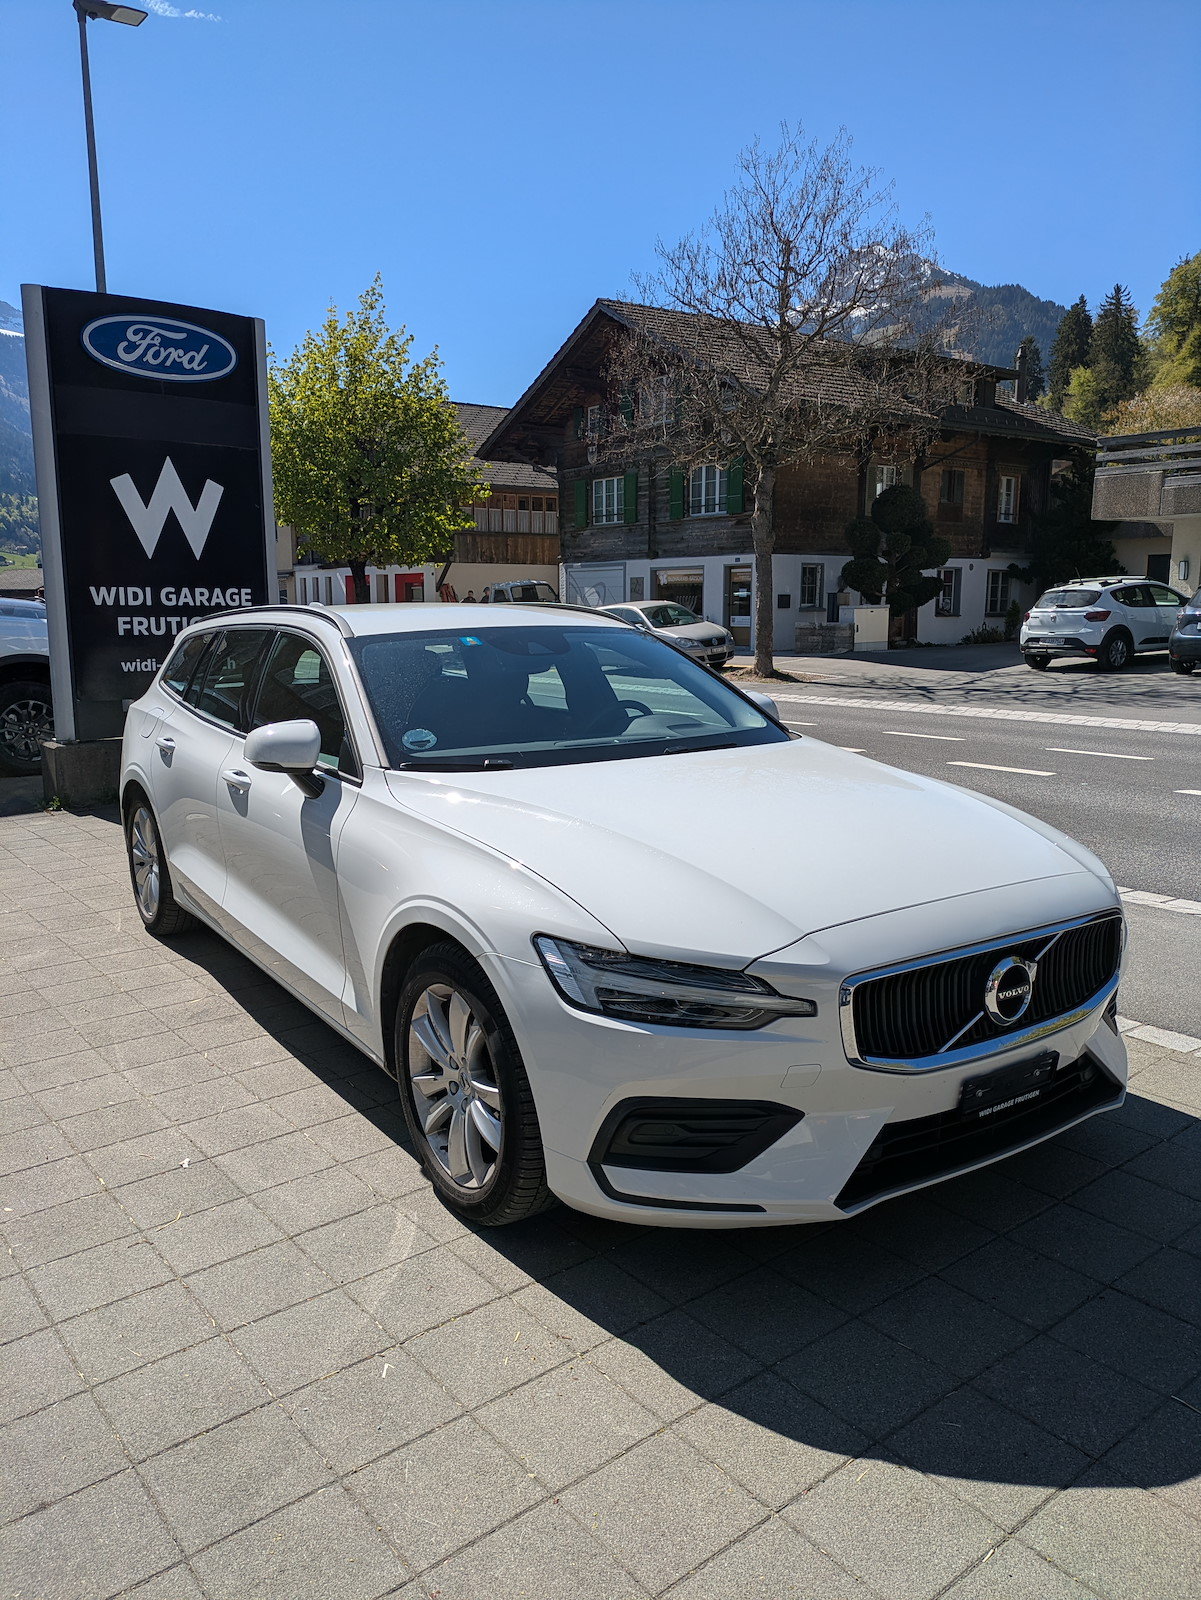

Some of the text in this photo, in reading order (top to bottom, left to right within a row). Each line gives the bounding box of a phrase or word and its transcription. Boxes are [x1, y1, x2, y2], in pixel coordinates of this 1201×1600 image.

[116, 324, 210, 371] Ford
[89, 586, 253, 607] WIDI GARAGE
[117, 616, 203, 636] FRUTI
[997, 984, 1030, 1000] VOLVO
[993, 1099, 1015, 1112] GARAGE
[1015, 1089, 1040, 1104] FRUTIGEN
